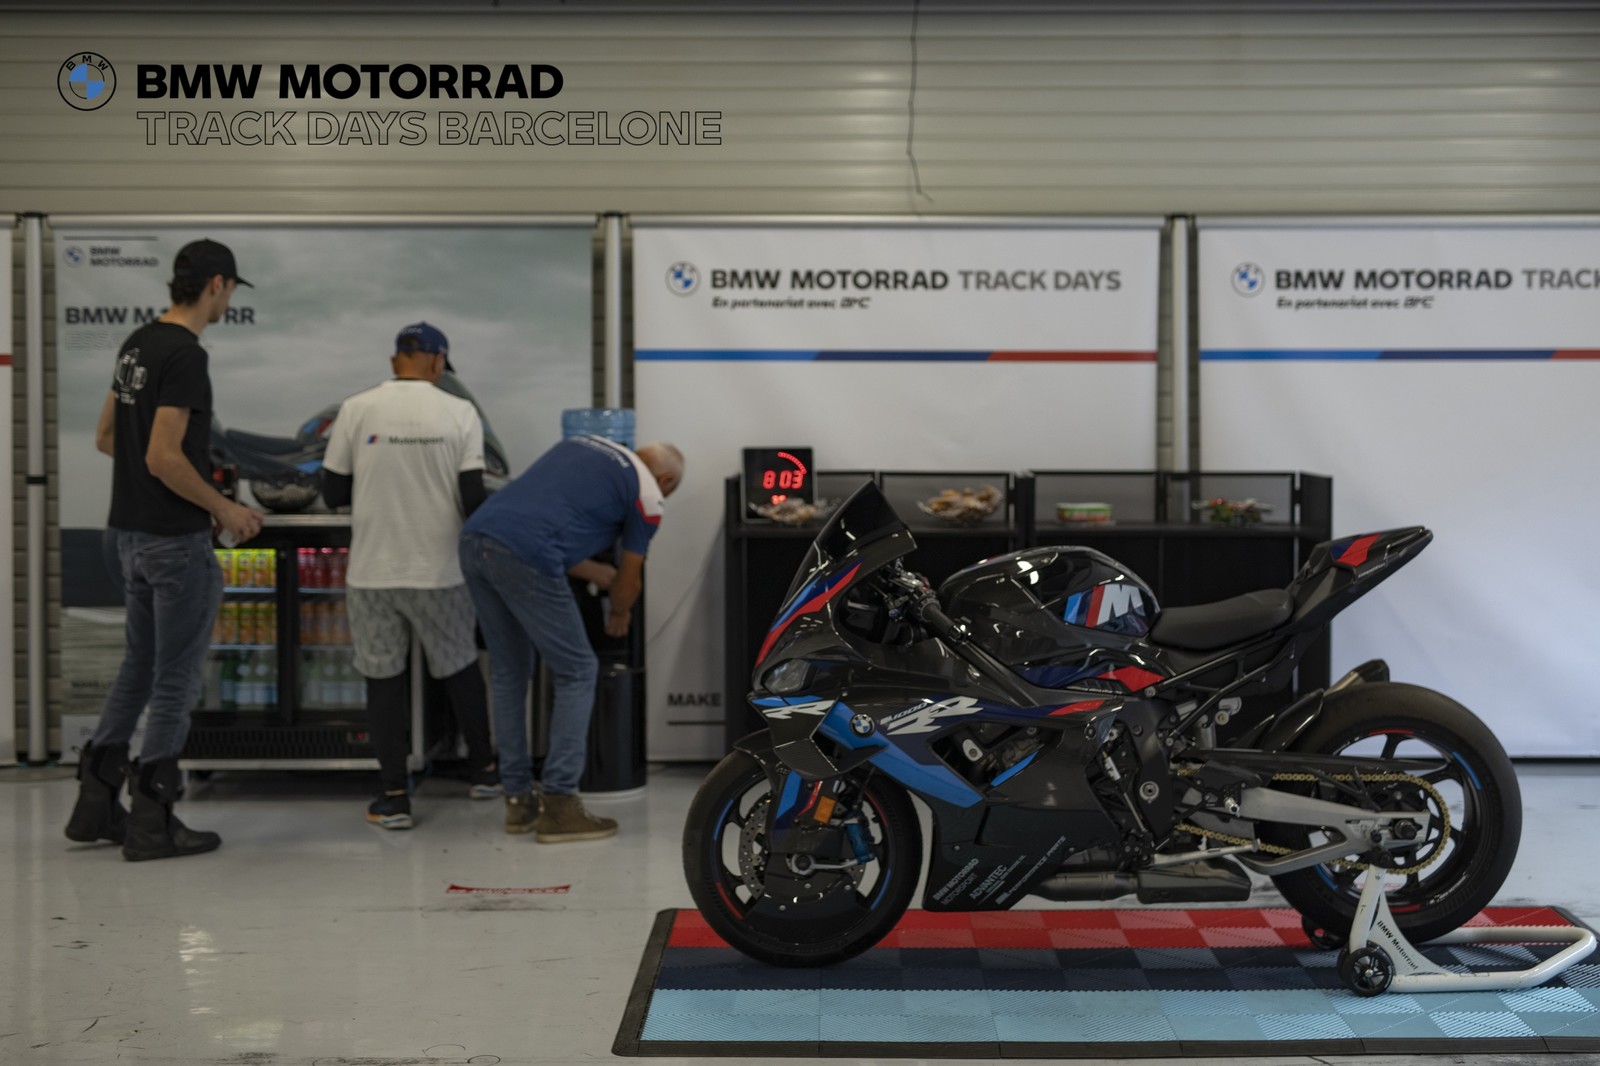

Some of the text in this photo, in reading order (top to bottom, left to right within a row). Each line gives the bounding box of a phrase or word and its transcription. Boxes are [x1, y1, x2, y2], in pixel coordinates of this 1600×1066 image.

[90, 256, 158, 267] MOTORRAD
[711, 269, 782, 290] BMW
[790, 269, 950, 290] MOTORRAD
[958, 269, 1047, 290] TRACK
[1054, 269, 1122, 290] DAYS
[1275, 269, 1346, 290] BMW
[1353, 269, 1513, 290] MOTORRAD
[711, 295, 730, 309] En
[731, 295, 805, 311] partenariat
[806, 297, 836, 309] avec
[1275, 295, 1293, 309] En
[1294, 295, 1369, 311] partenariat
[1370, 297, 1400, 309] avec
[65, 307, 128, 325] BMW
[224, 307, 256, 325] RR
[388, 435, 446, 447] Motorsport
[667, 691, 722, 708] MAKE
[887, 695, 984, 736] RR
[946, 858, 979, 890] MOTORRAD
[969, 864, 1008, 900] ADVANTEC
[940, 871, 979, 906] MOTORSPORT
[1376, 919, 1419, 970] BMW Motorrad
